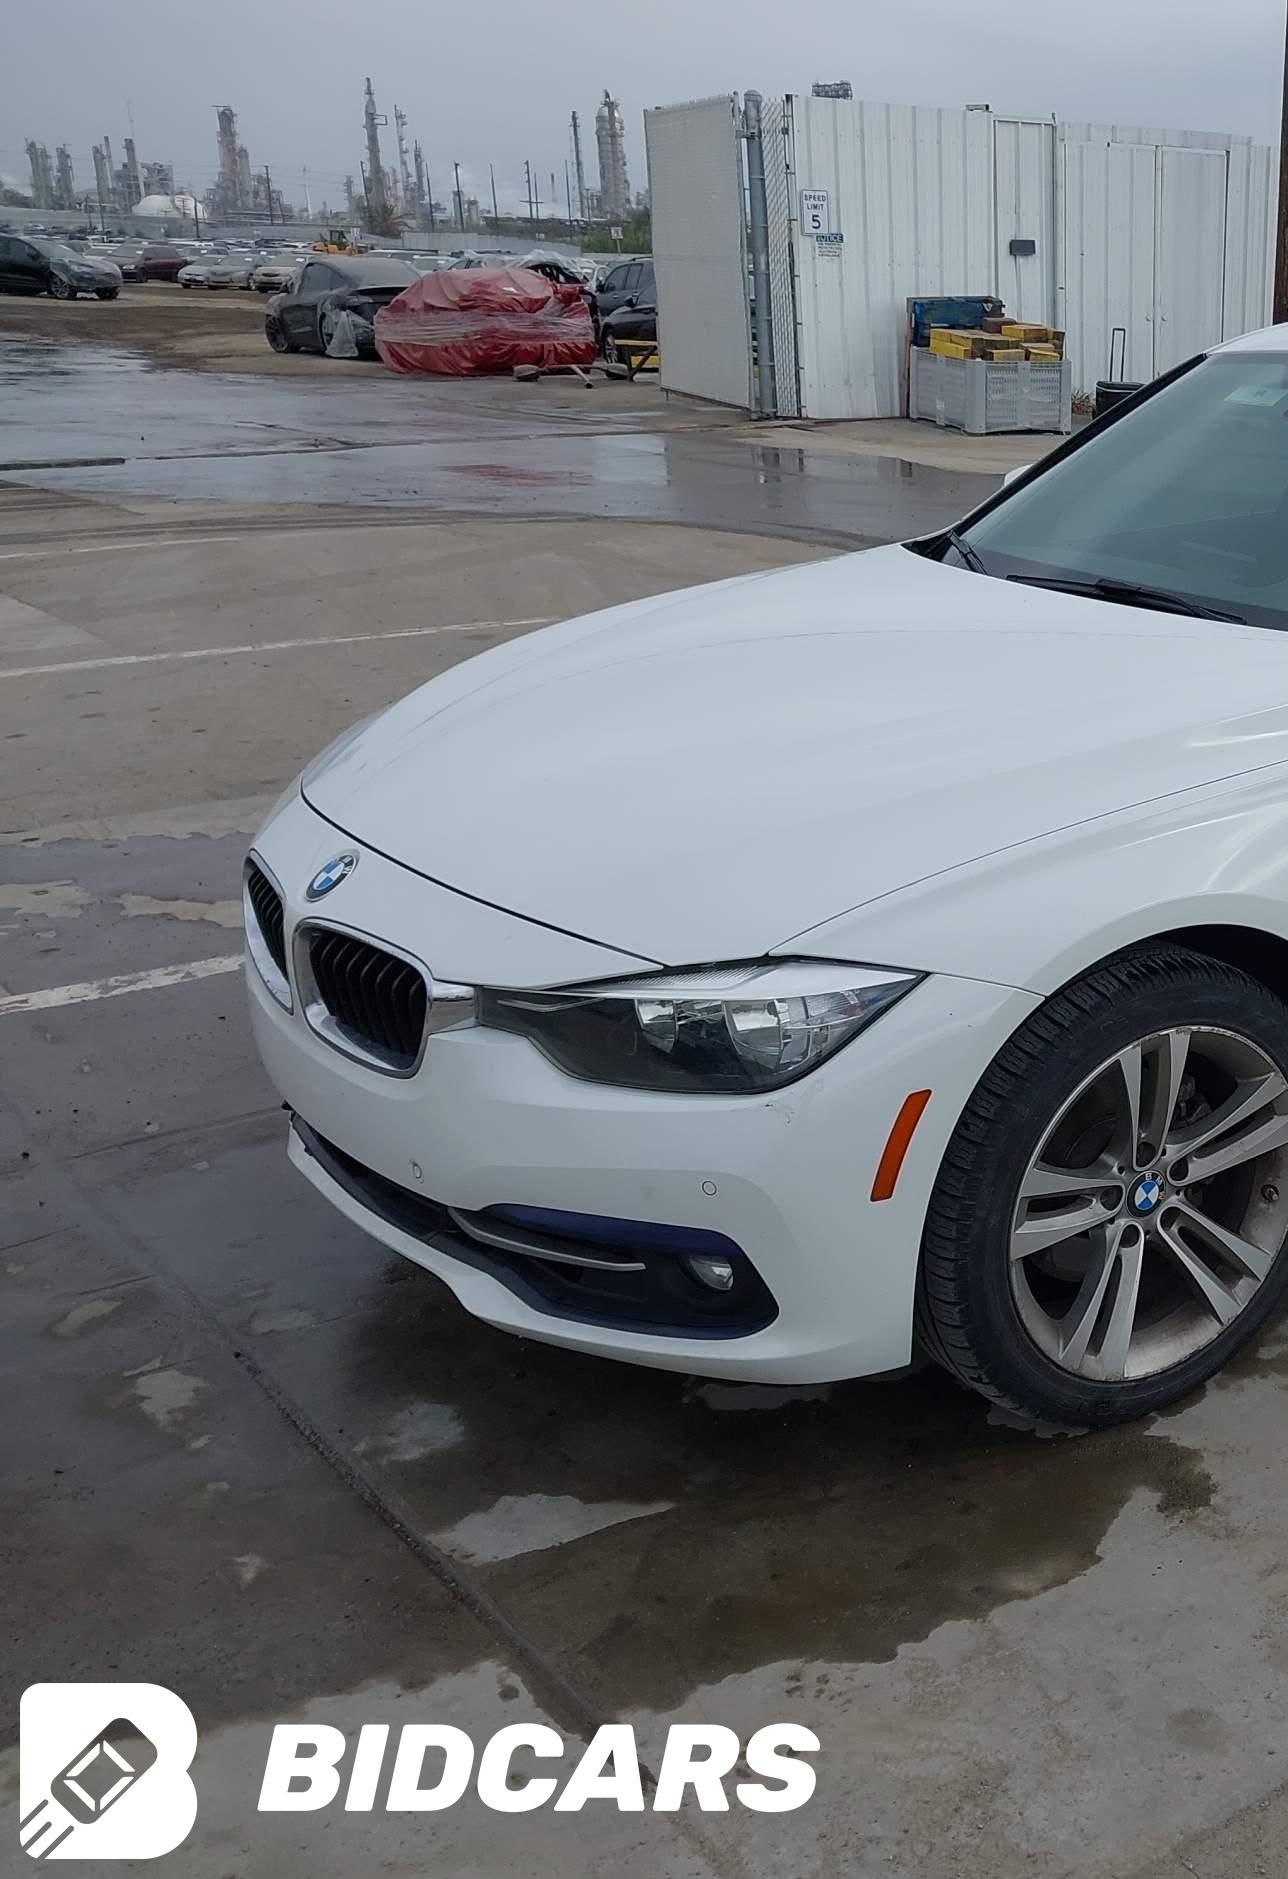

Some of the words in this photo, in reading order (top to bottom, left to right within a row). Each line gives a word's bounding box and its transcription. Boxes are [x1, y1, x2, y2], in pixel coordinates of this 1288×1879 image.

[804, 194, 827, 202] SPEED
[806, 203, 825, 211] LIMIT
[811, 214, 822, 230] 5
